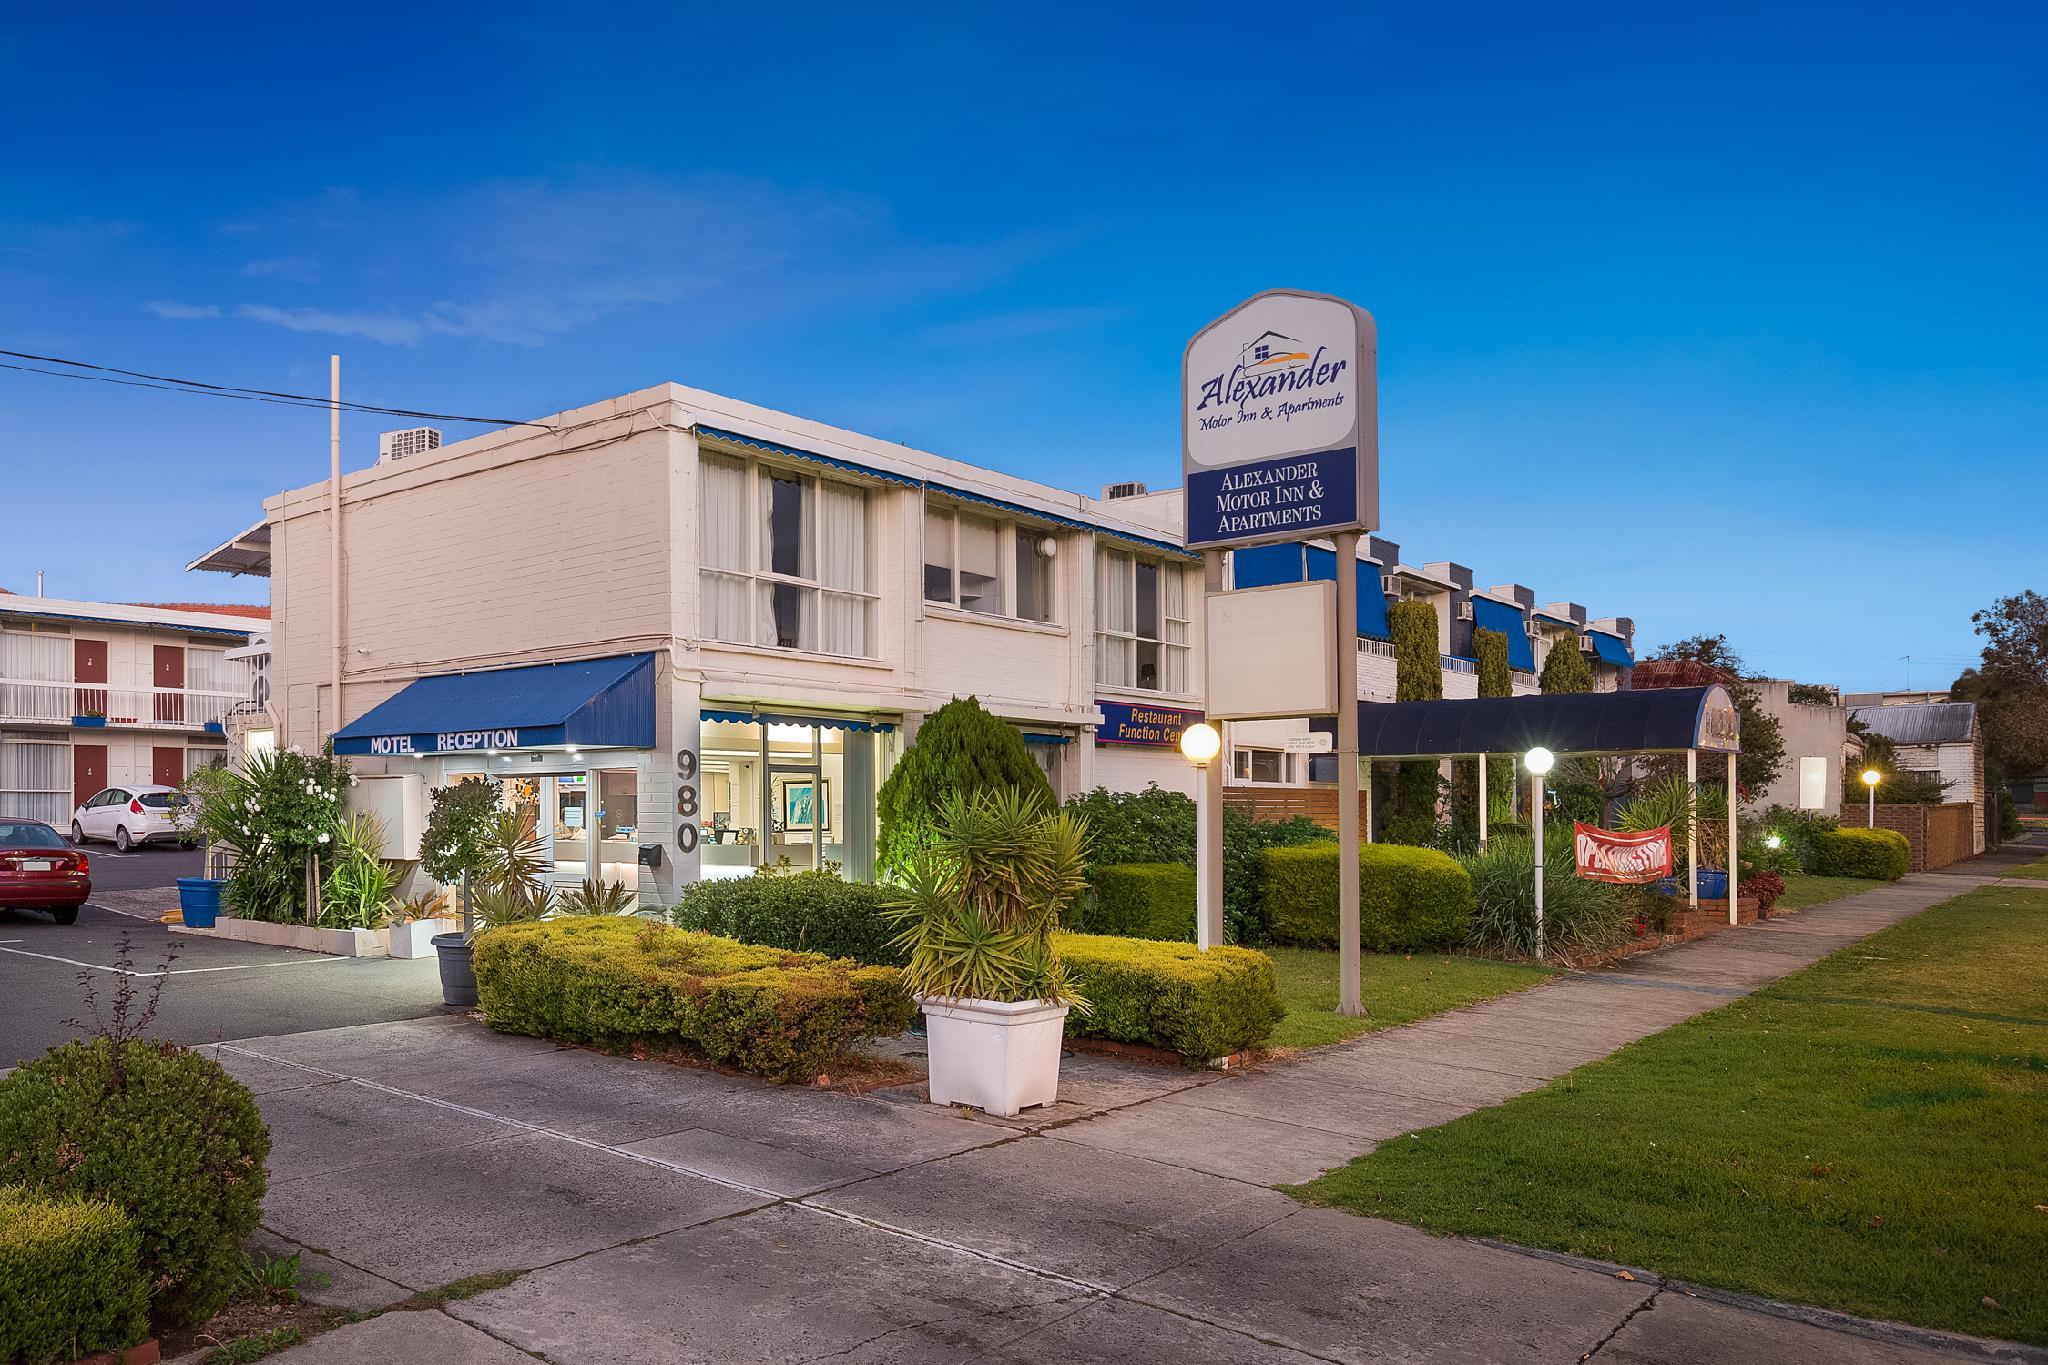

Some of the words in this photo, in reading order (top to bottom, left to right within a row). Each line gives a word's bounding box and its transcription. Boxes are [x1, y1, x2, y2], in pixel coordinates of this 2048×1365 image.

[1196, 345, 1347, 411] Alexander
[1199, 413, 1233, 431] Motor
[1237, 409, 1257, 424] Inn
[1260, 406, 1273, 421] &
[1276, 391, 1344, 423] Apartments
[1220, 462, 1319, 492] ALEXANDER
[1216, 490, 1271, 513] MOTOR
[1275, 485, 1305, 504] INN
[1308, 479, 1324, 500] &
[1217, 504, 1322, 533] APARTMENTS
[1131, 707, 1182, 726] Restaurant
[370, 735, 415, 754] MOTEL
[437, 729, 518, 751] RECEPTION
[1118, 723, 1161, 741] Function
[677, 749, 698, 853] 980
